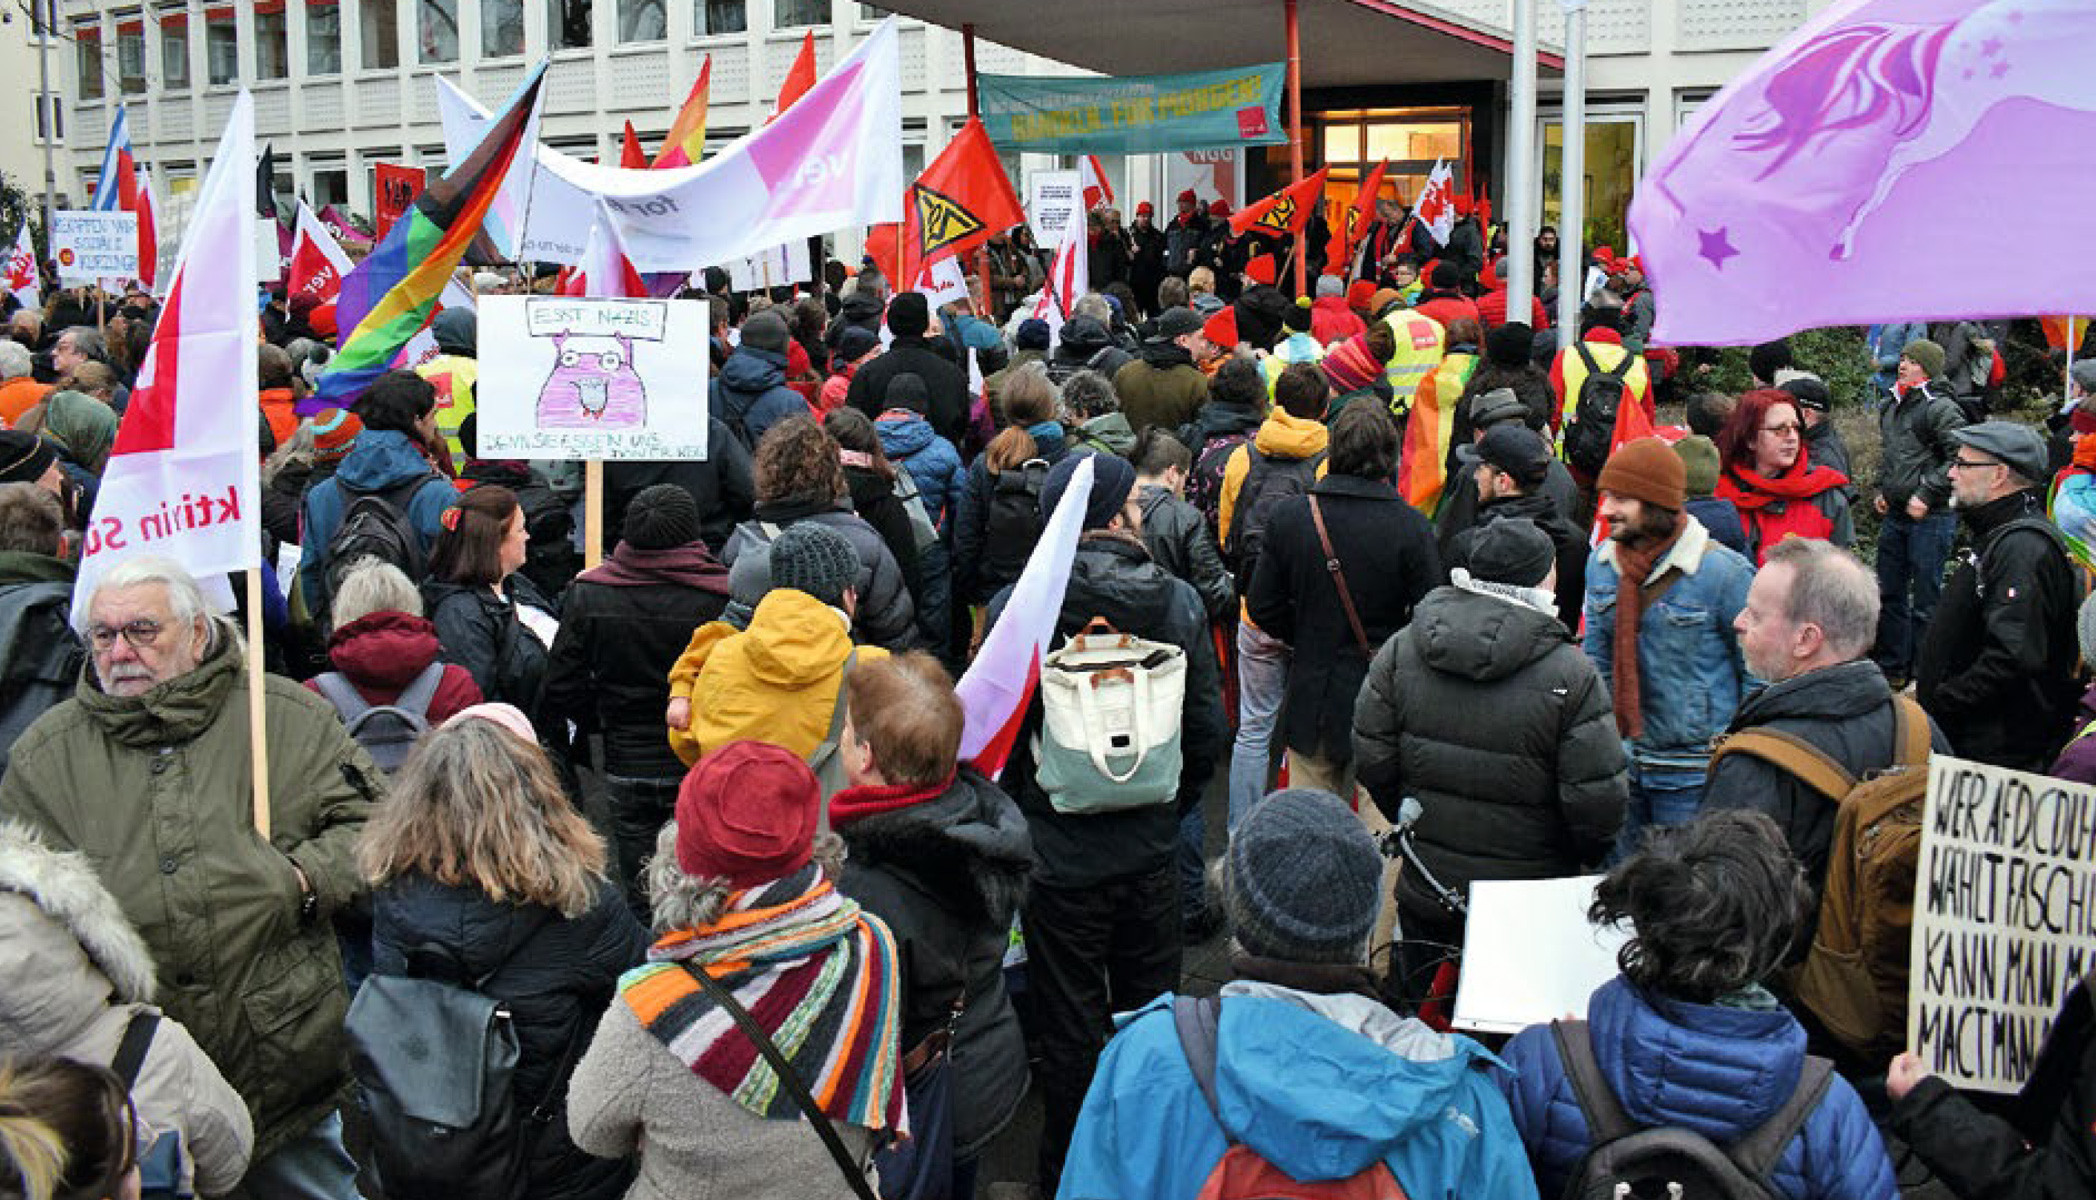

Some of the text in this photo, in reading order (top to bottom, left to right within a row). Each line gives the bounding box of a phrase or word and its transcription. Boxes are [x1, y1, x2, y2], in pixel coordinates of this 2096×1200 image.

[1933, 767, 1986, 843] WER
[1924, 925, 1999, 1001] KANN
[2002, 937, 2058, 1008] MAN
[1917, 1001, 1988, 1079] MACT
